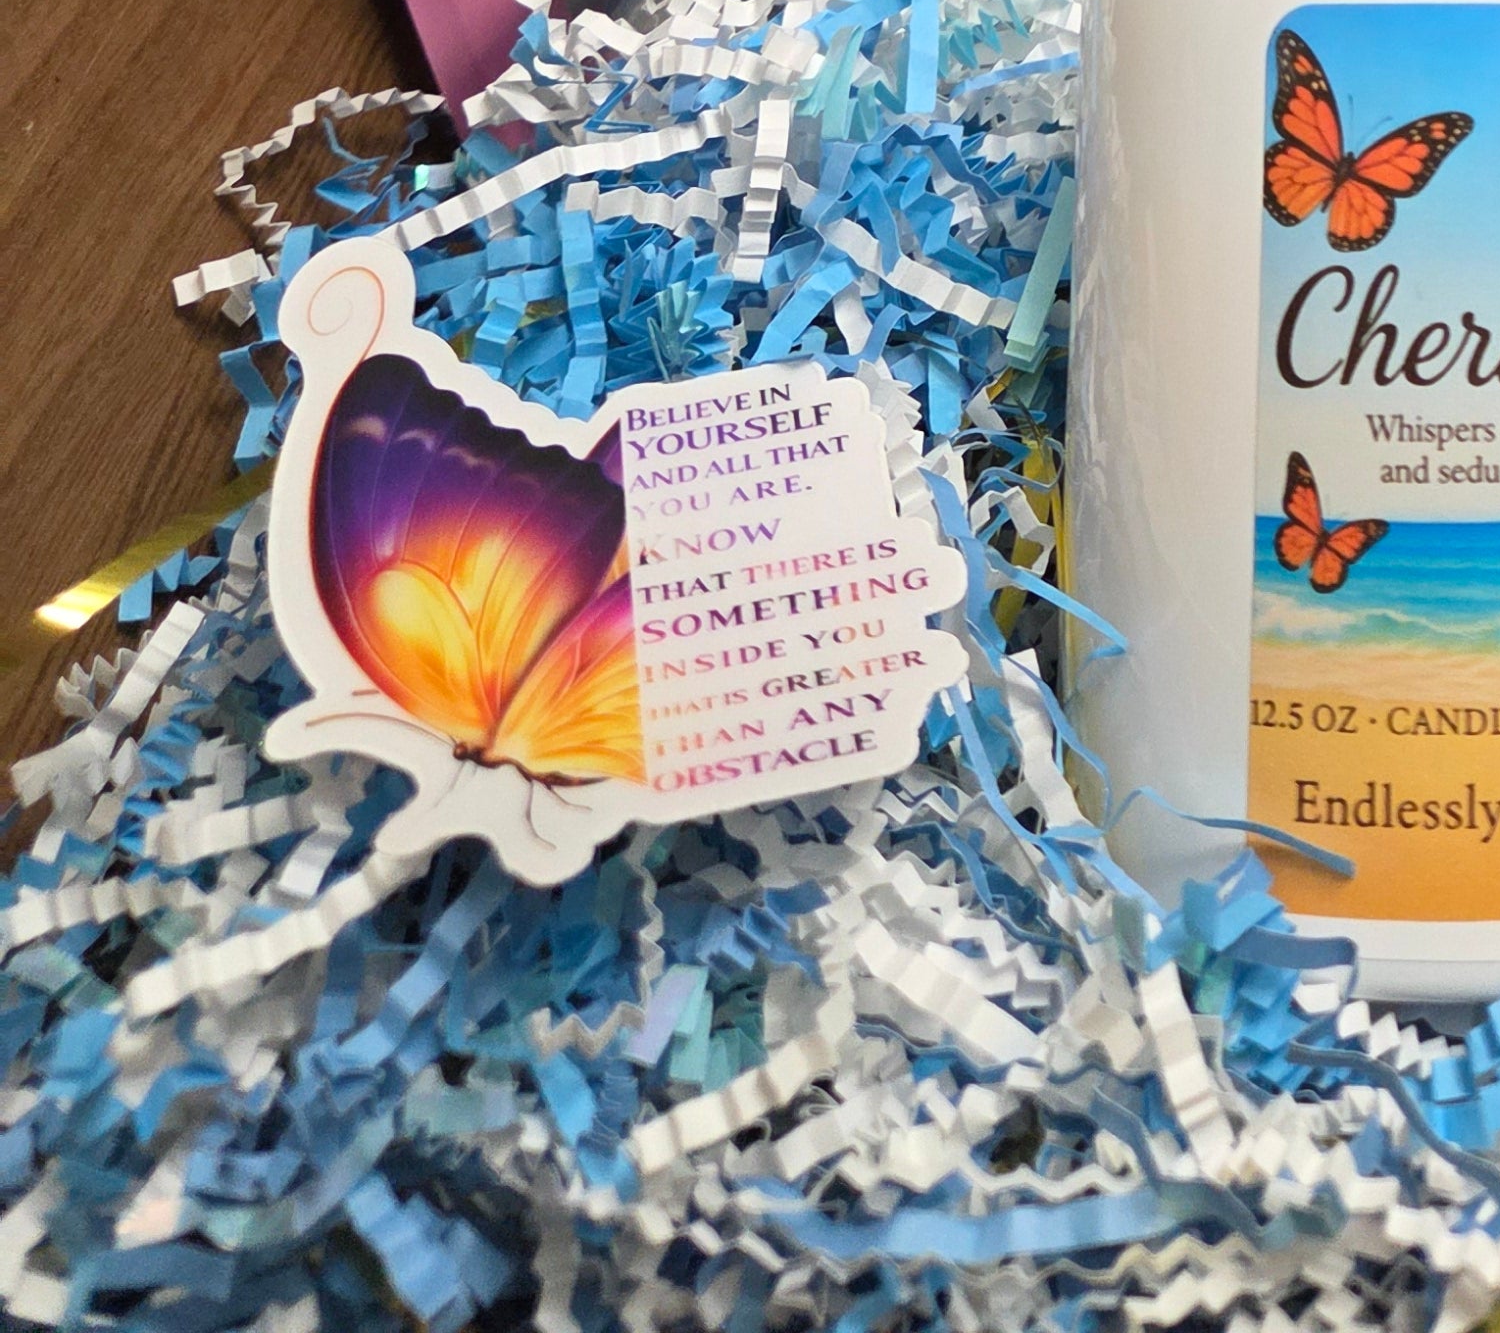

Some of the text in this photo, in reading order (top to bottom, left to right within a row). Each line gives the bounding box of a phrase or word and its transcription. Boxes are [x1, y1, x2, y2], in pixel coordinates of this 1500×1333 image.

[759, 383, 791, 406] IN
[627, 402, 833, 460] YOURSELF
[1367, 413, 1496, 451] Whispers
[630, 434, 850, 493] AND ALL THAT
[1380, 455, 1430, 484] and
[632, 475, 813, 520] YOU ARE.
[637, 538, 898, 604] THAT THERE IS
[638, 518, 782, 566] KNOW
[641, 567, 930, 644] SOMETHING
[644, 619, 885, 683] INSIDE YOU
[649, 650, 927, 720] THAT IS GREATER
[653, 688, 894, 756] THAN ANY
[1250, 699, 1303, 731] 12.5
[1312, 703, 1358, 734] OZ
[653, 729, 878, 793] OBSTACLE
